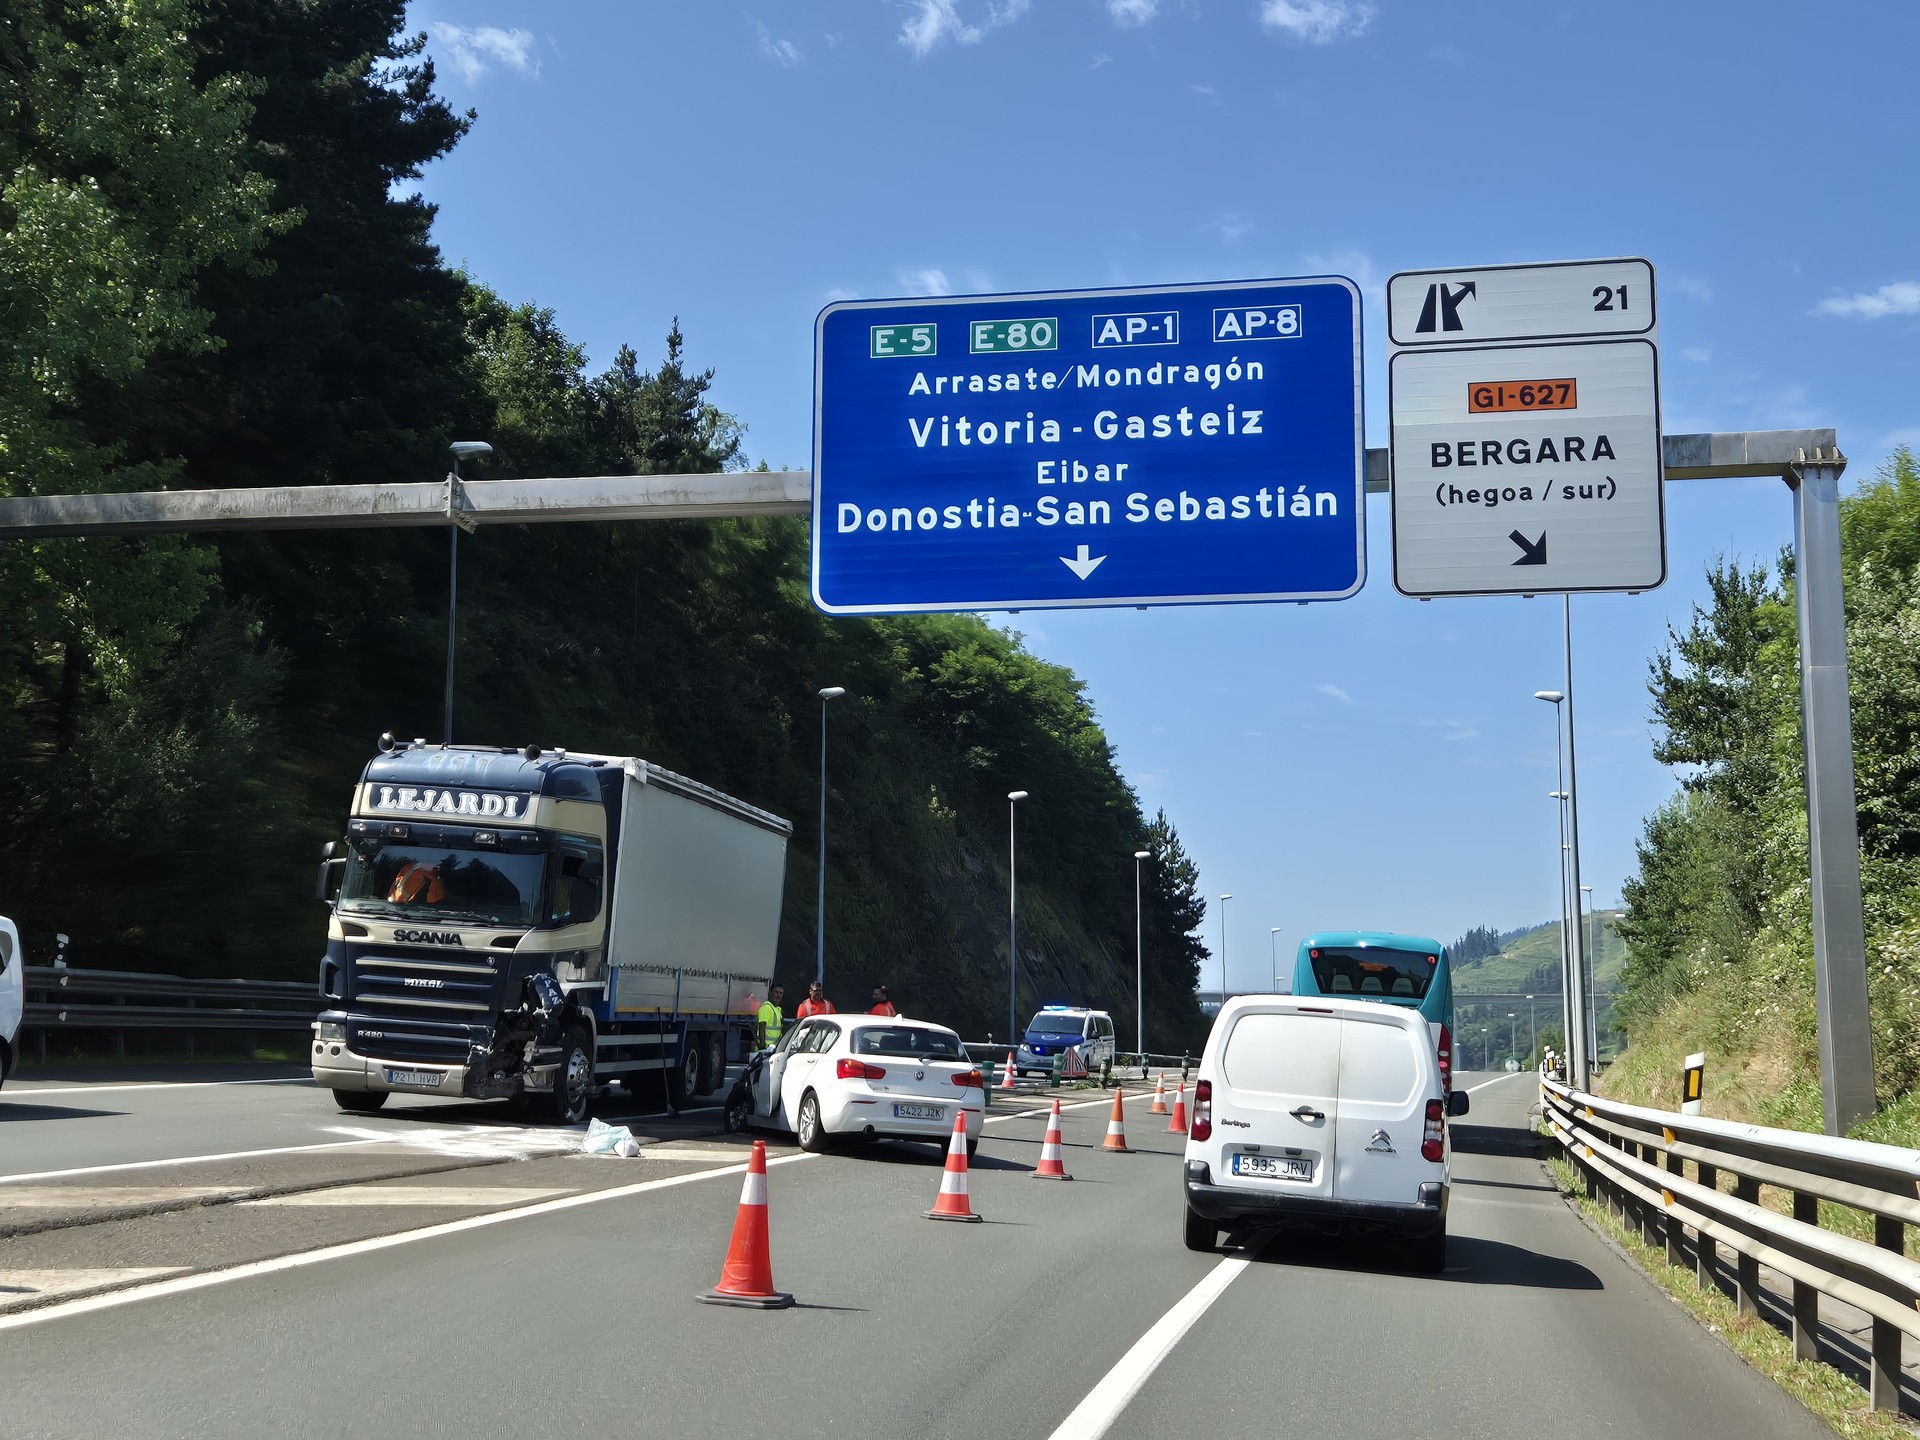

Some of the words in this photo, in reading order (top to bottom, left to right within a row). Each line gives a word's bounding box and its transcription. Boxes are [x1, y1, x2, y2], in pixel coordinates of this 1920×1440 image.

[1592, 284, 1628, 312] 21
[975, 321, 1053, 349] E-80
[1098, 315, 1174, 343] AP-1
[1218, 309, 1298, 337] AP-8
[876, 327, 931, 353] E-5
[908, 356, 1264, 395] Arrasate/Mondragón
[1474, 383, 1571, 408] GI-627
[908, 411, 1061, 448] Vitoria
[1093, 404, 1263, 440] Gasteiz
[1430, 434, 1617, 468] BERGARA
[1037, 459, 1129, 484] Eibar
[1435, 482, 1534, 507] (hegoa
[1562, 475, 1617, 501] sur)
[837, 495, 1111, 533] Donostia-San
[1125, 485, 1338, 523] Sebastián
[378, 786, 518, 816] LEJARDI
[393, 929, 463, 946] SCANIA
[394, 1072, 416, 1083] 7211
[900, 1106, 921, 1117] 5422
[925, 1107, 941, 1118] JZK
[1242, 1157, 1277, 1173] 5935
[1282, 1163, 1308, 1176] JRV
